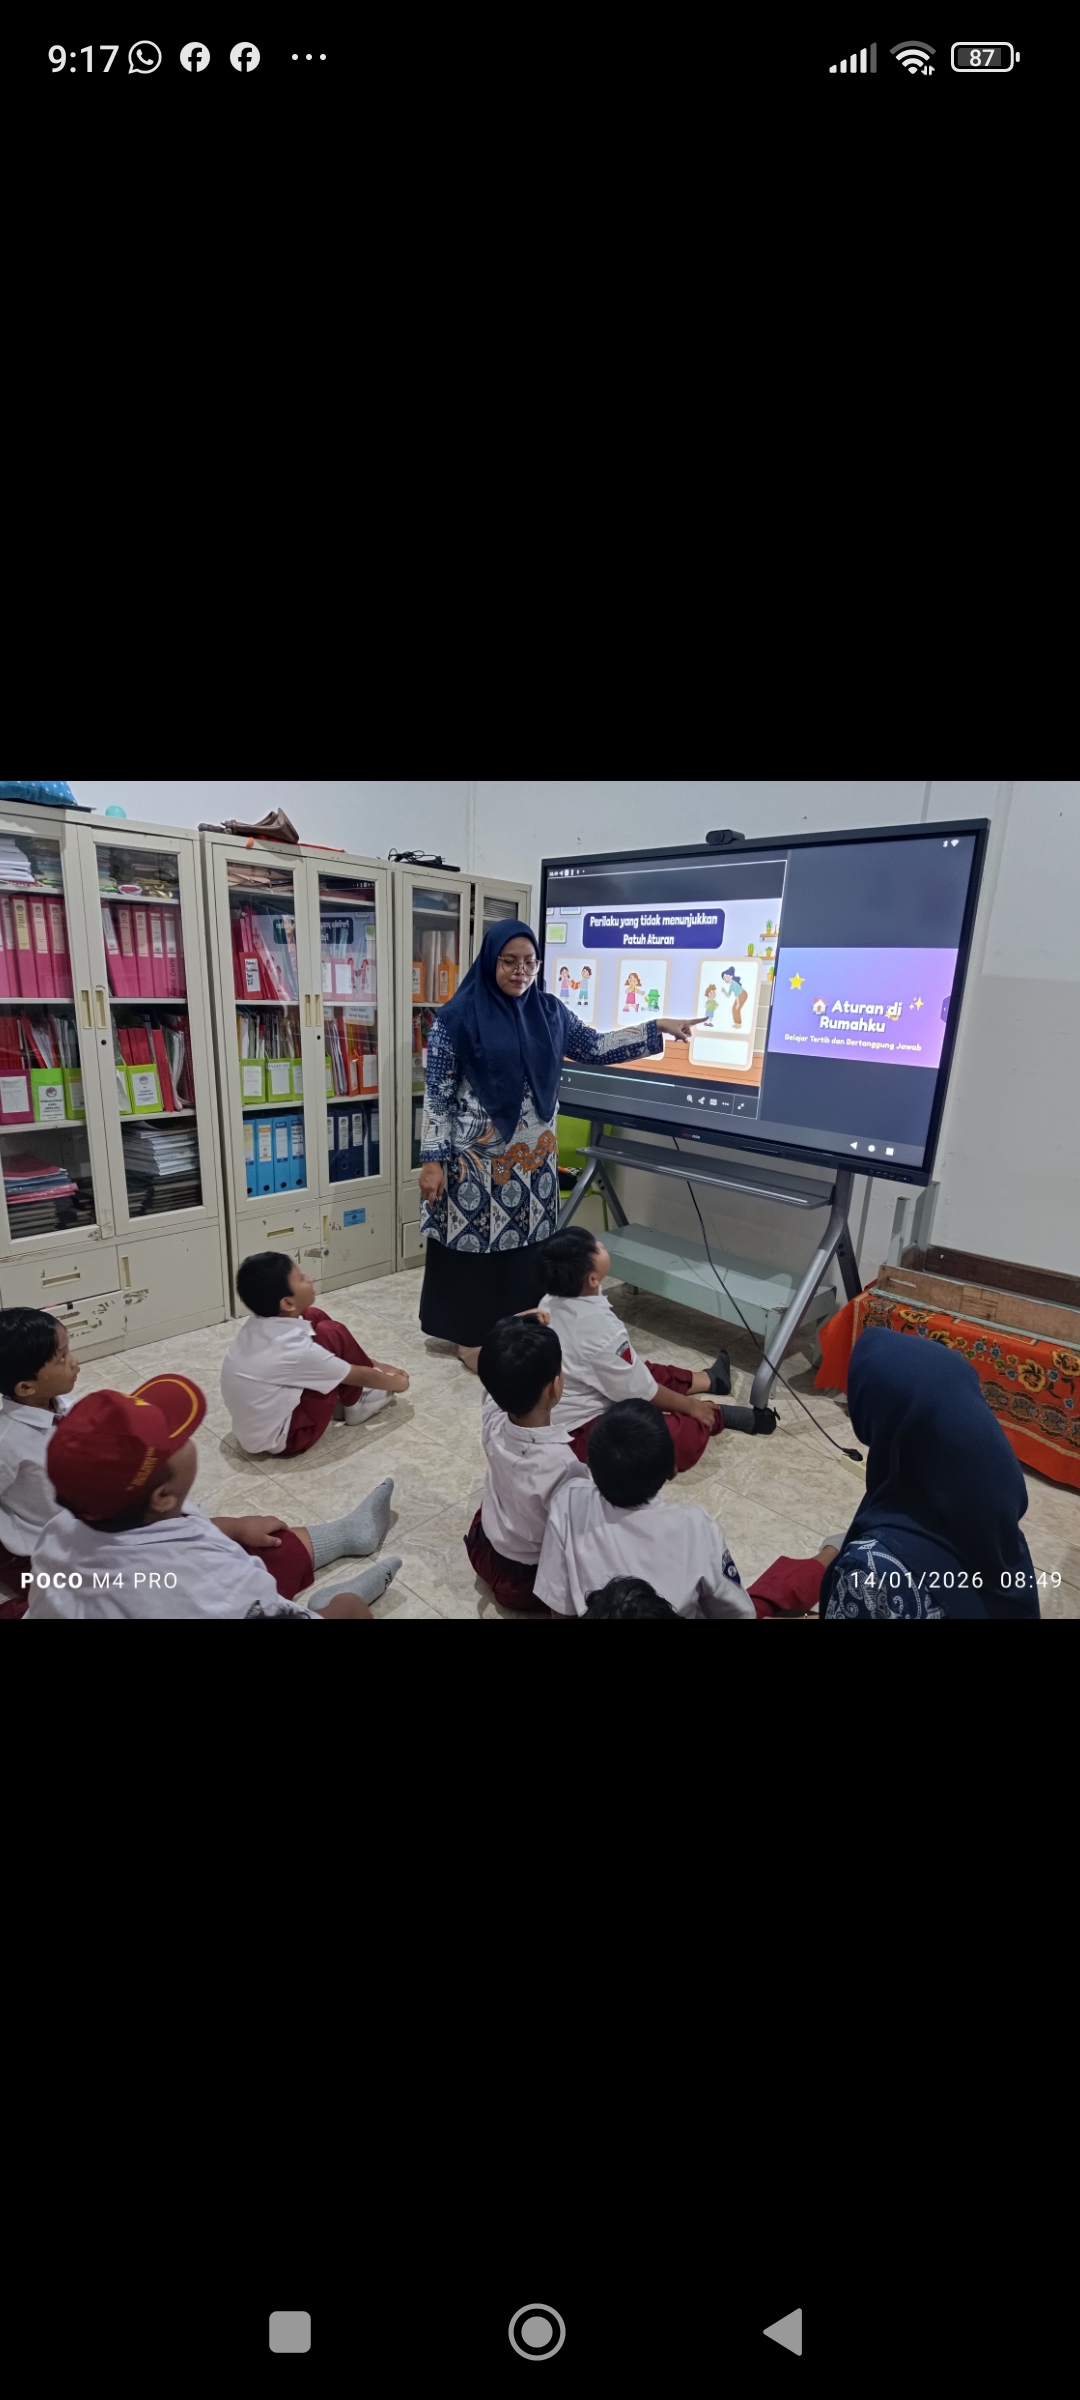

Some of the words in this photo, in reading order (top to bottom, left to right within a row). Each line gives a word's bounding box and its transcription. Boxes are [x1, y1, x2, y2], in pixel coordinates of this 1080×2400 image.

[590, 916, 619, 927] Perilaku
[619, 917, 639, 929] yang
[640, 914, 661, 926] tidak
[662, 912, 718, 928] menunjukkan
[623, 934, 646, 945] Patuh
[647, 934, 675, 945] Aturan
[831, 999, 884, 1015] Aturan
[887, 1001, 903, 1018] di
[819, 1015, 886, 1033] Rumahku
[784, 1033, 808, 1043] Belajar
[809, 1035, 830, 1044] Tertib
[831, 1037, 845, 1045] dan
[846, 1038, 895, 1050] Bertanggung
[896, 1042, 922, 1051] Jawab
